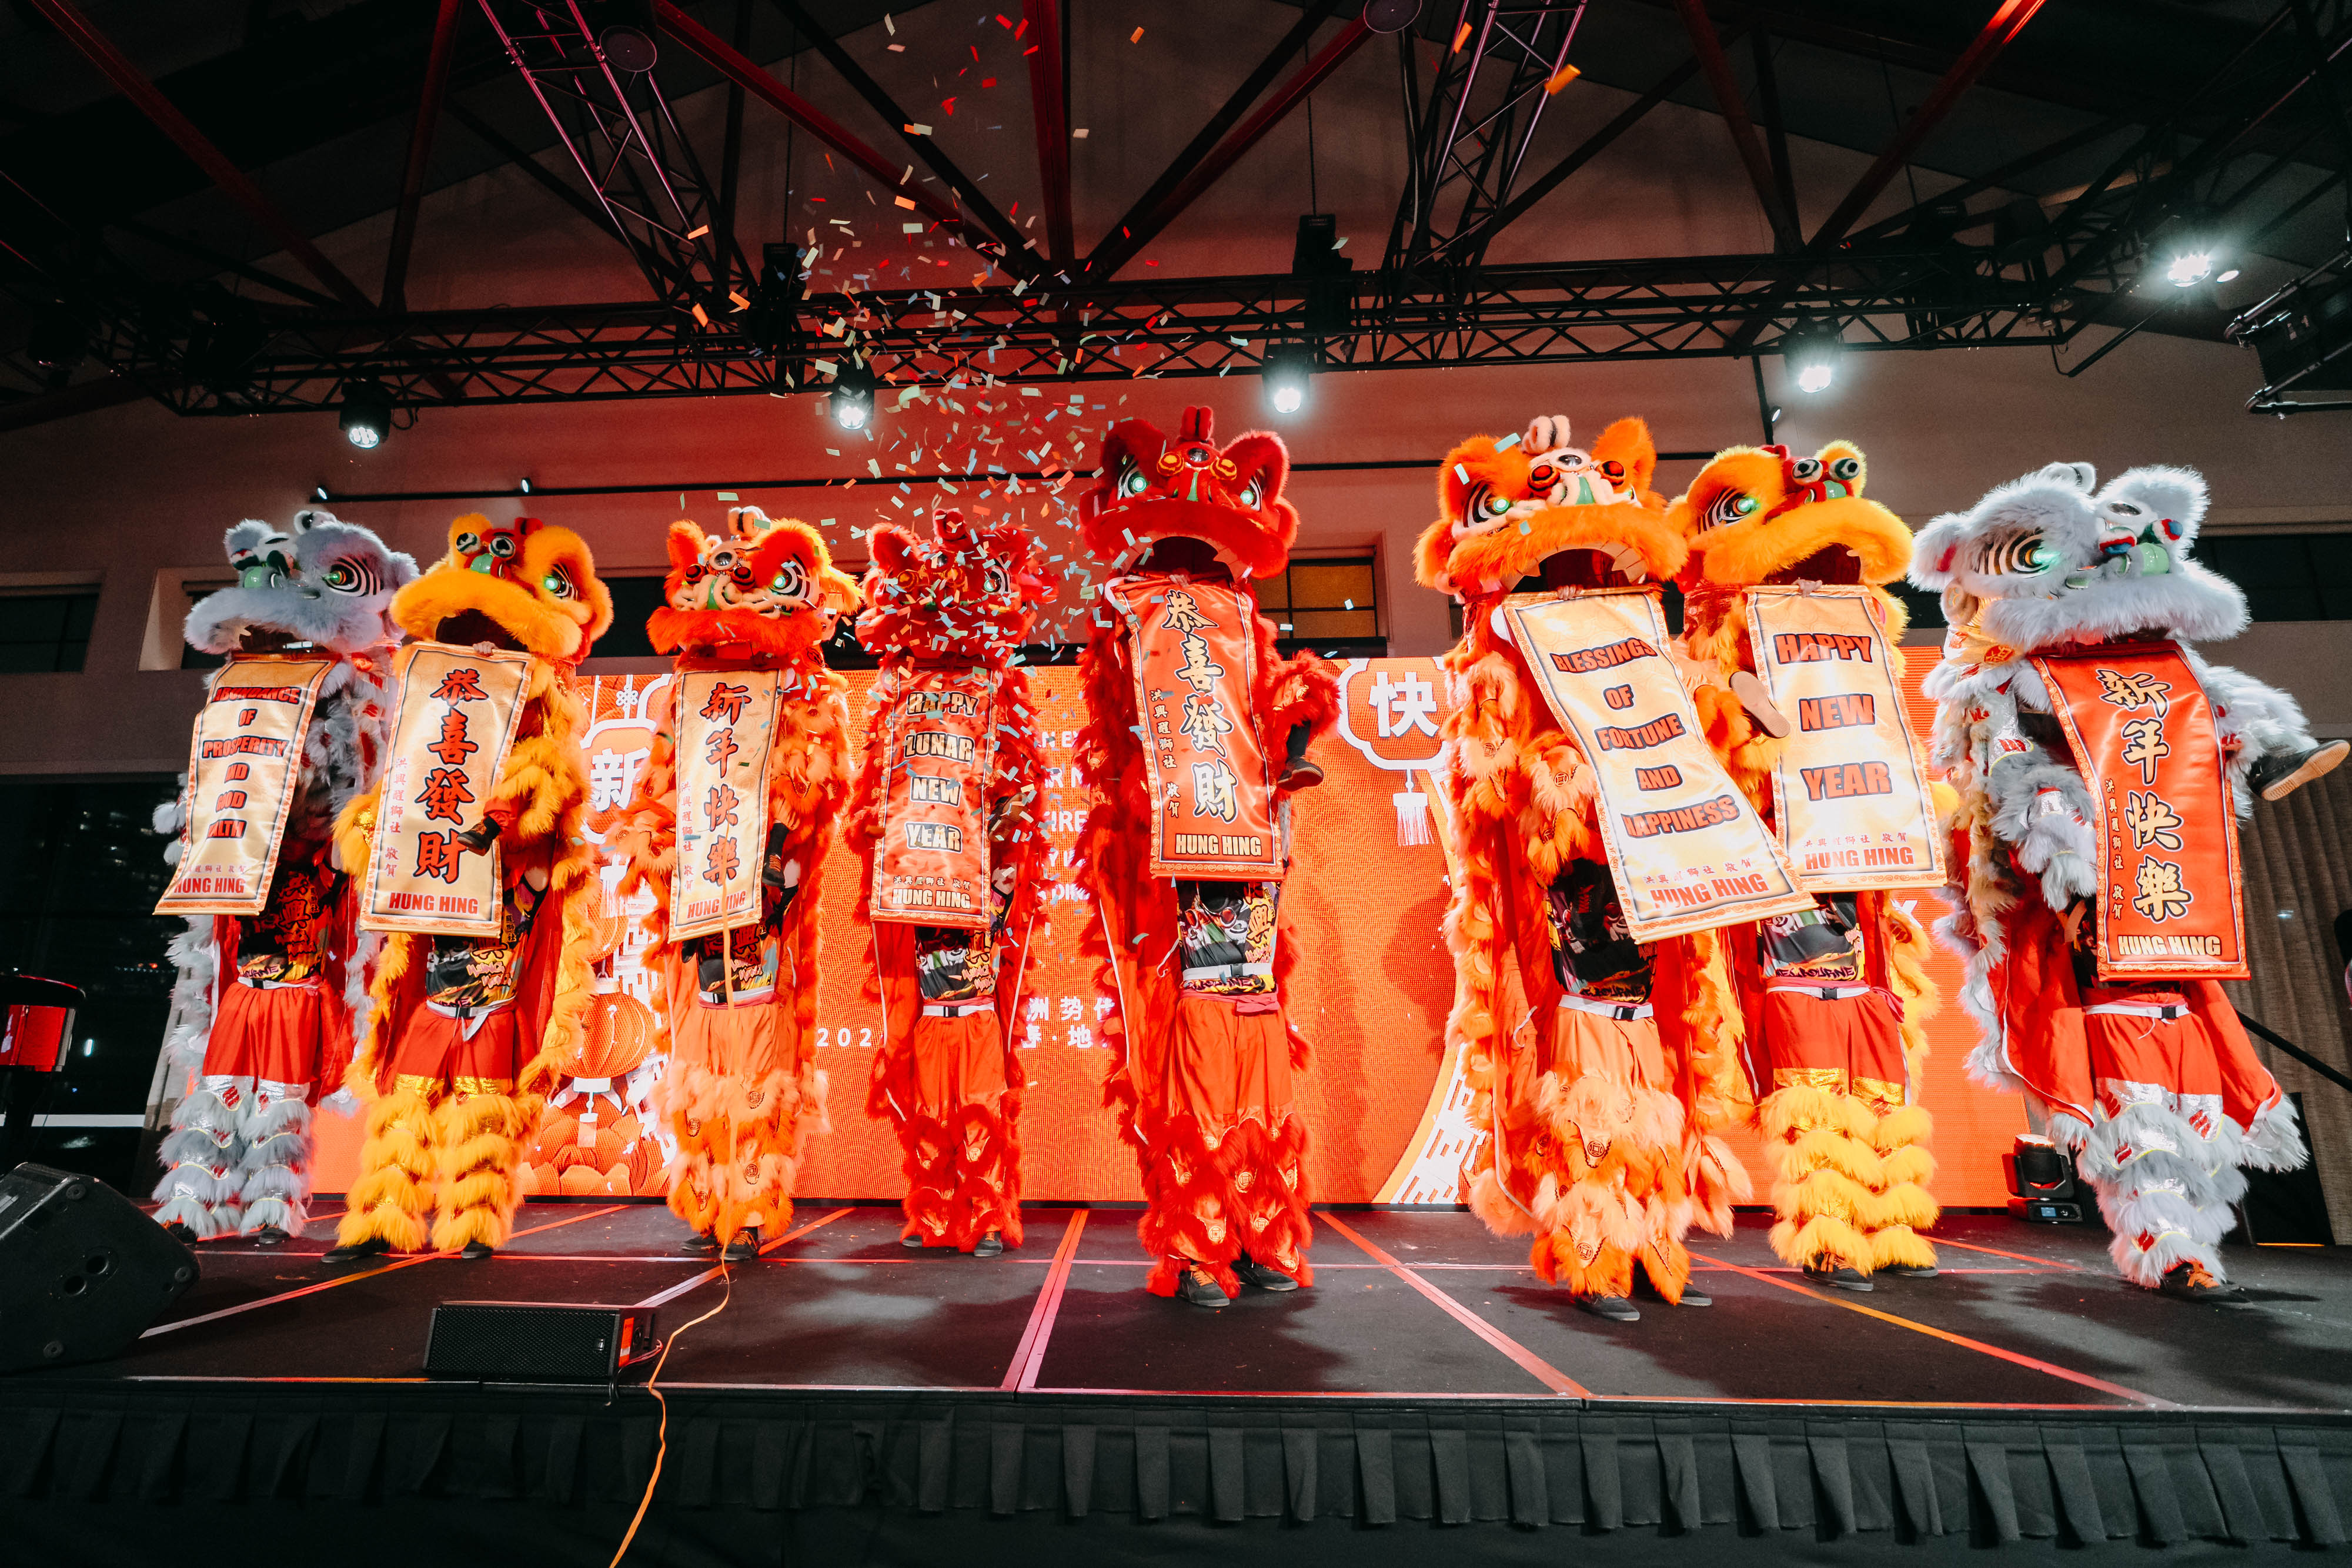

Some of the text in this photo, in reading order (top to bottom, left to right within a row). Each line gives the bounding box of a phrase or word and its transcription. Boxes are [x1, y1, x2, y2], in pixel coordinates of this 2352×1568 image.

[1549, 637, 1658, 673] BLESSINGS
[1773, 633, 1873, 664] HAPPY
[211, 687, 302, 704] ABUNDANCE
[907, 692, 979, 716] HAPPY
[1161, 590, 1237, 823] 恭喜發財
[1368, 671, 1439, 737] 快
[1603, 684, 1634, 710] OF
[238, 709, 258, 727] OF
[1799, 694, 1875, 731] NEW
[202, 735, 289, 758] PROSPERITY
[904, 732, 974, 762] LUNAR
[1595, 713, 1686, 751] FORTUNE
[413, 668, 489, 884] 恭喜發財
[590, 747, 651, 812] 新
[700, 682, 752, 887] 新年快樂
[1636, 764, 1682, 791] AND
[1800, 761, 1892, 801] YEAR
[911, 776, 961, 807] NEW
[1166, 781, 1180, 818] 敬賀
[2097, 670, 2192, 922] 新年快樂
[385, 758, 407, 877] 洪興醒獅社 敬賀
[1621, 795, 1740, 838] HAPPINESS
[905, 823, 962, 852] YEAR
[1175, 833, 1262, 856] HUNG HING
[1882, 832, 1907, 842] 敬賀
[1805, 847, 1914, 870] HUNG HING
[173, 878, 245, 893] HUNG HING
[892, 888, 970, 909] HUNG HING
[953, 879, 971, 891] 敬賀
[1650, 874, 1769, 908] HUNG HING
[389, 892, 478, 914] HUNG HING
[687, 898, 720, 918] HUNG
[2112, 884, 2124, 921] 敬賀
[2117, 935, 2222, 956] HUNG HING
[1776, 965, 1855, 978] MELBOURNE
